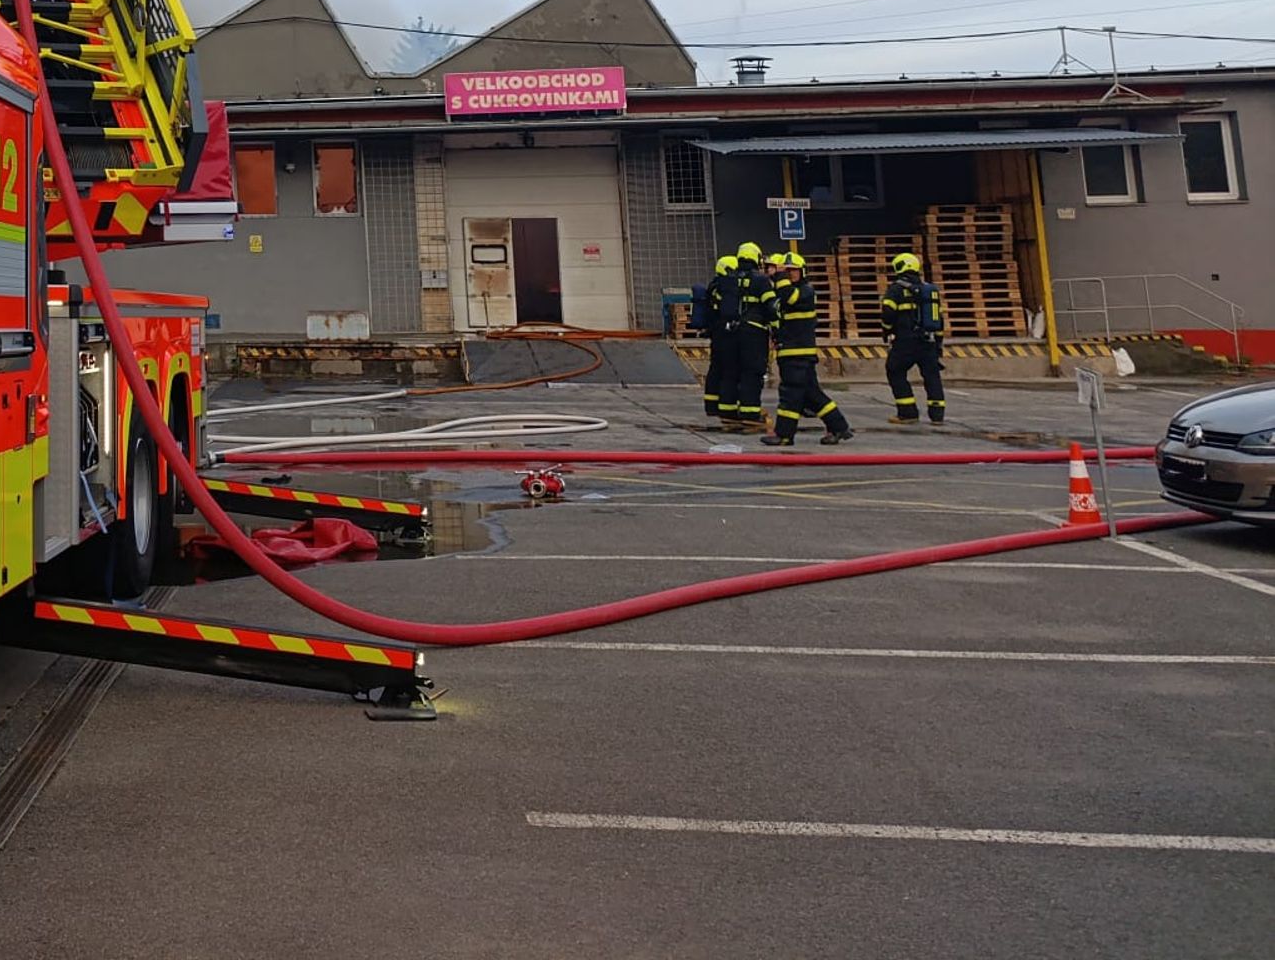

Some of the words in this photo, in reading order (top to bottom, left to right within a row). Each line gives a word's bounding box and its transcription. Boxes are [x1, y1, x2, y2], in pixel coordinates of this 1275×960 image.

[461, 73, 605, 91] VELKOOBCHOD
[451, 96, 462, 110] S
[468, 90, 619, 108] CUKROVINKAMI
[784, 210, 799, 228] P
